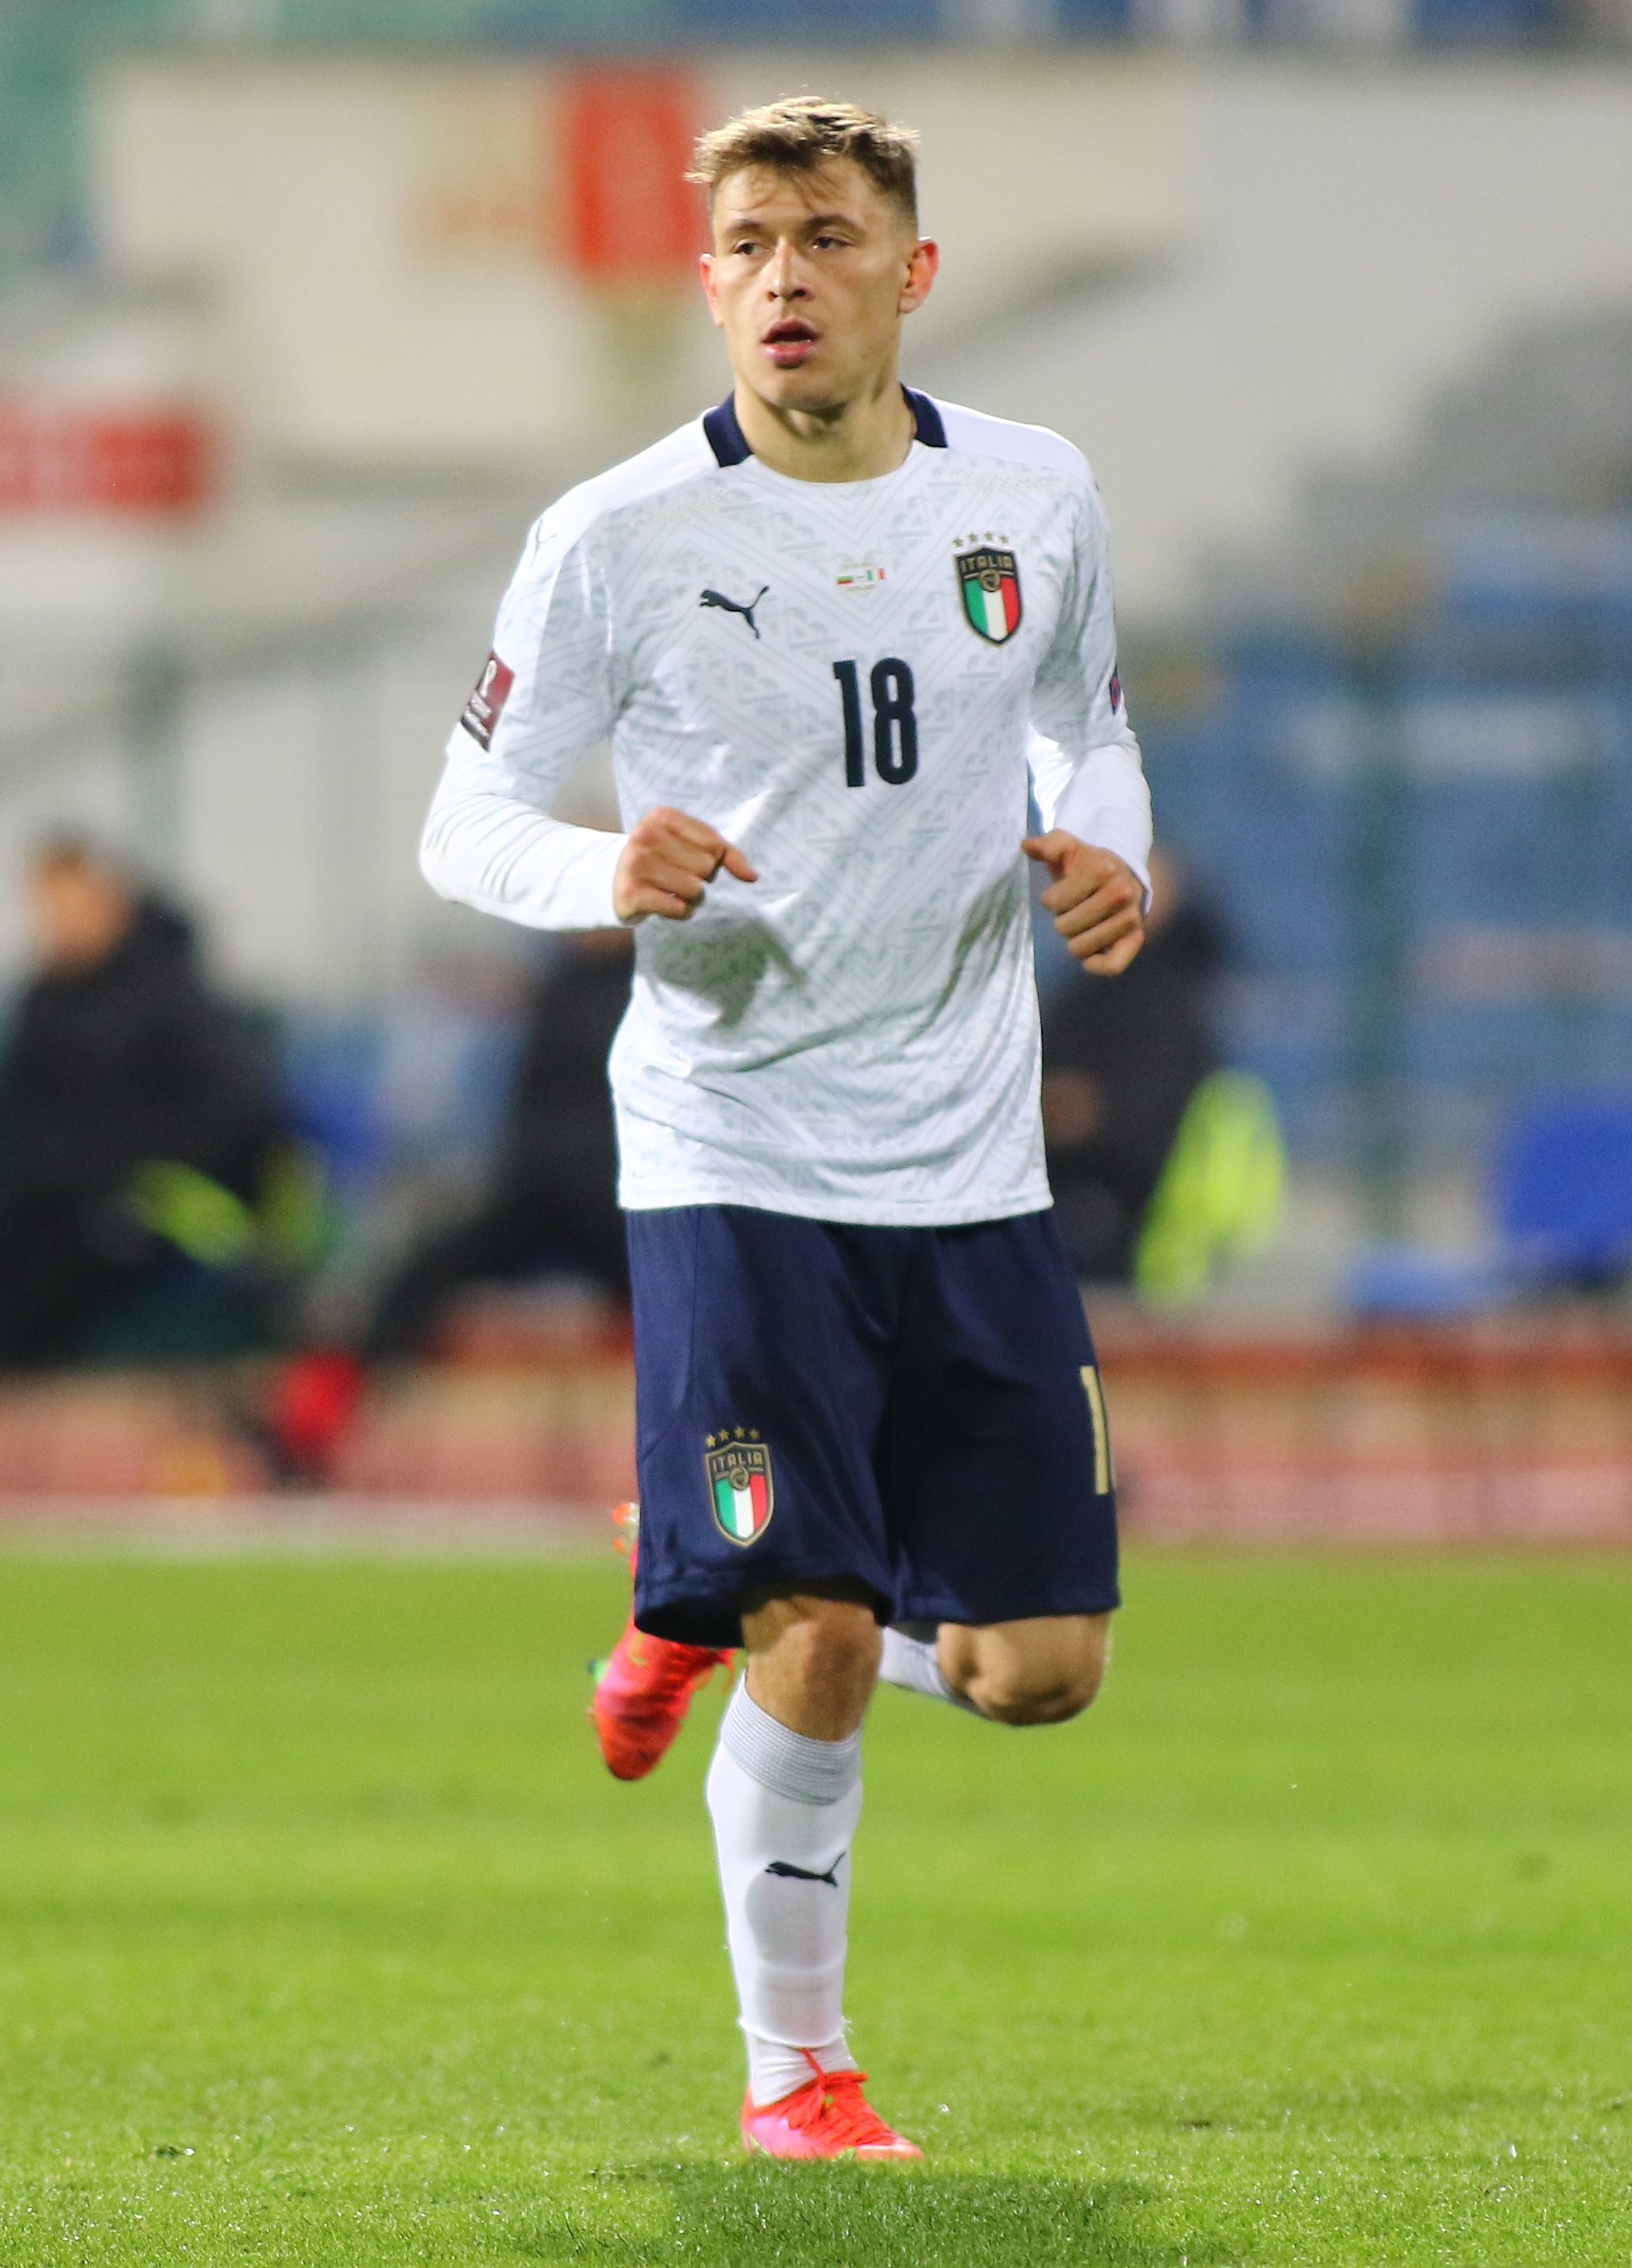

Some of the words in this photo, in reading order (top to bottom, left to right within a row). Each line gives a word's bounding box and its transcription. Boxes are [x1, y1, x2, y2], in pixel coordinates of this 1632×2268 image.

[959, 554, 1014, 573] ITALIA
[832, 657, 919, 787] 18
[712, 1451, 764, 1472] ITALIA
